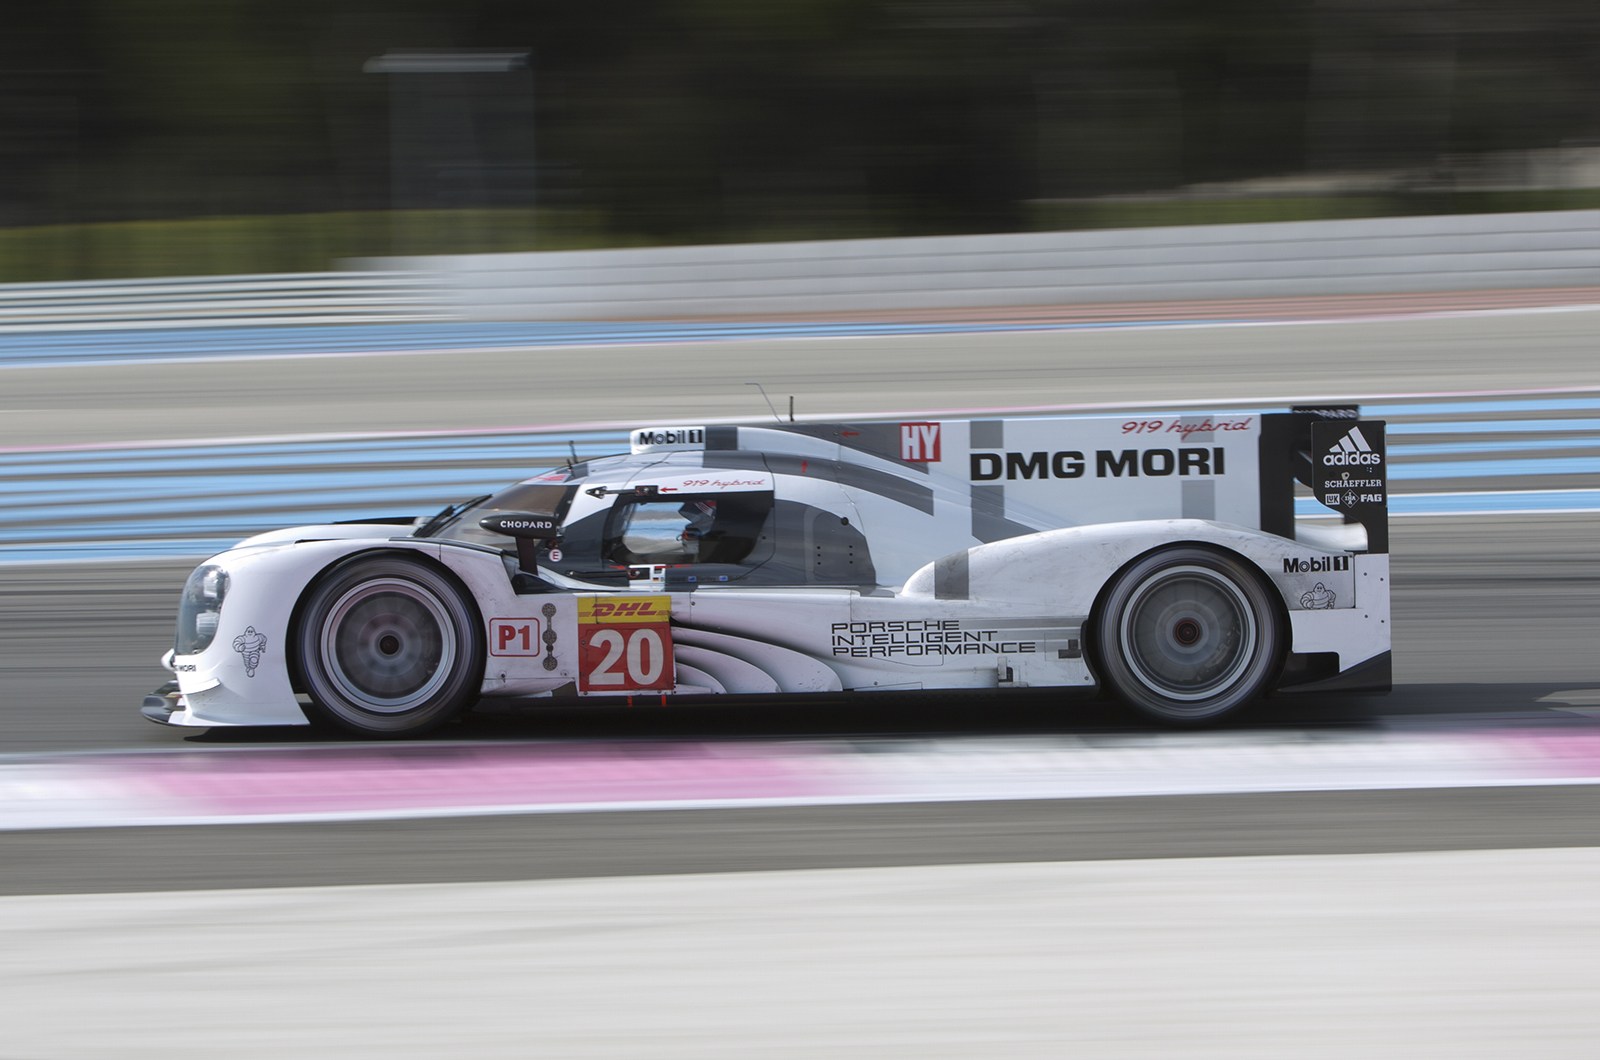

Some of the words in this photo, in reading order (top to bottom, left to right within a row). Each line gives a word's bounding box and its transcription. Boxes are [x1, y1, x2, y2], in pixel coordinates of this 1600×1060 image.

[1121, 420, 1163, 434] 919
[1165, 417, 1253, 441] hybrid
[640, 430, 686, 445] Mobil
[689, 429, 703, 444] 1
[901, 425, 938, 460] HY
[970, 451, 1085, 481] DMG
[1096, 447, 1225, 478] MORI
[1323, 451, 1381, 466] adidas
[710, 479, 766, 489] hybrid
[1324, 479, 1382, 488] SCHAEFFLER
[1360, 494, 1382, 503] FAG
[500, 520, 552, 530] CHOPARD
[552, 551, 559, 560] E
[1283, 556, 1331, 573] Mobil
[1333, 555, 1349, 571] 1
[591, 602, 657, 617] DHL
[831, 620, 960, 634] PORSCHE
[498, 625, 530, 651] P1
[832, 631, 998, 646] INTELLIGENT
[588, 628, 664, 686] 20
[833, 642, 1036, 657] PERFORMANCE
